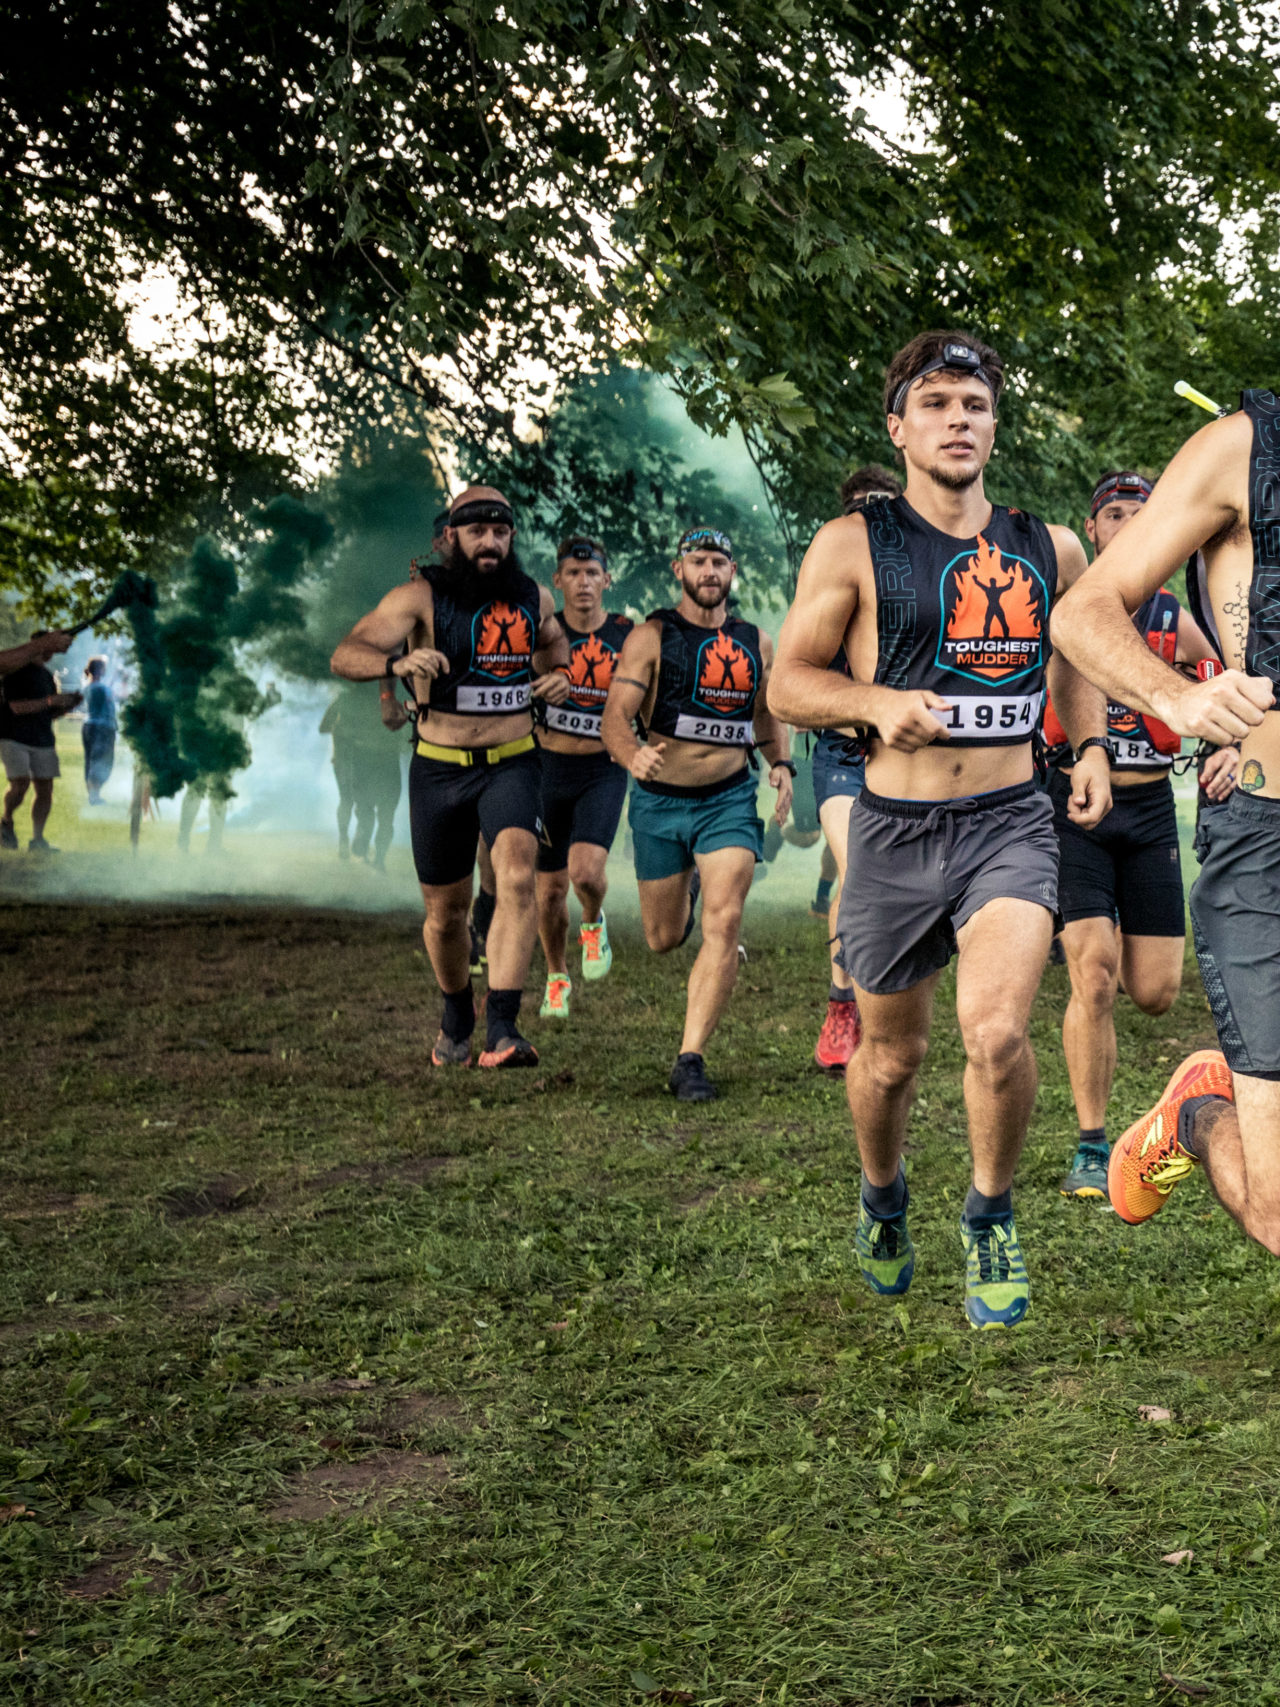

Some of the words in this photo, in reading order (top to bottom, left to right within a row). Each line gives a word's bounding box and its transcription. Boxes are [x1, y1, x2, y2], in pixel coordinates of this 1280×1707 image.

[944, 640, 1040, 653] TOUGHEST
[475, 654, 530, 663] TOUGHEST
[956, 653, 1028, 665] MUDDER
[698, 687, 750, 699] TOUGHEST
[946, 701, 1031, 729] 1954
